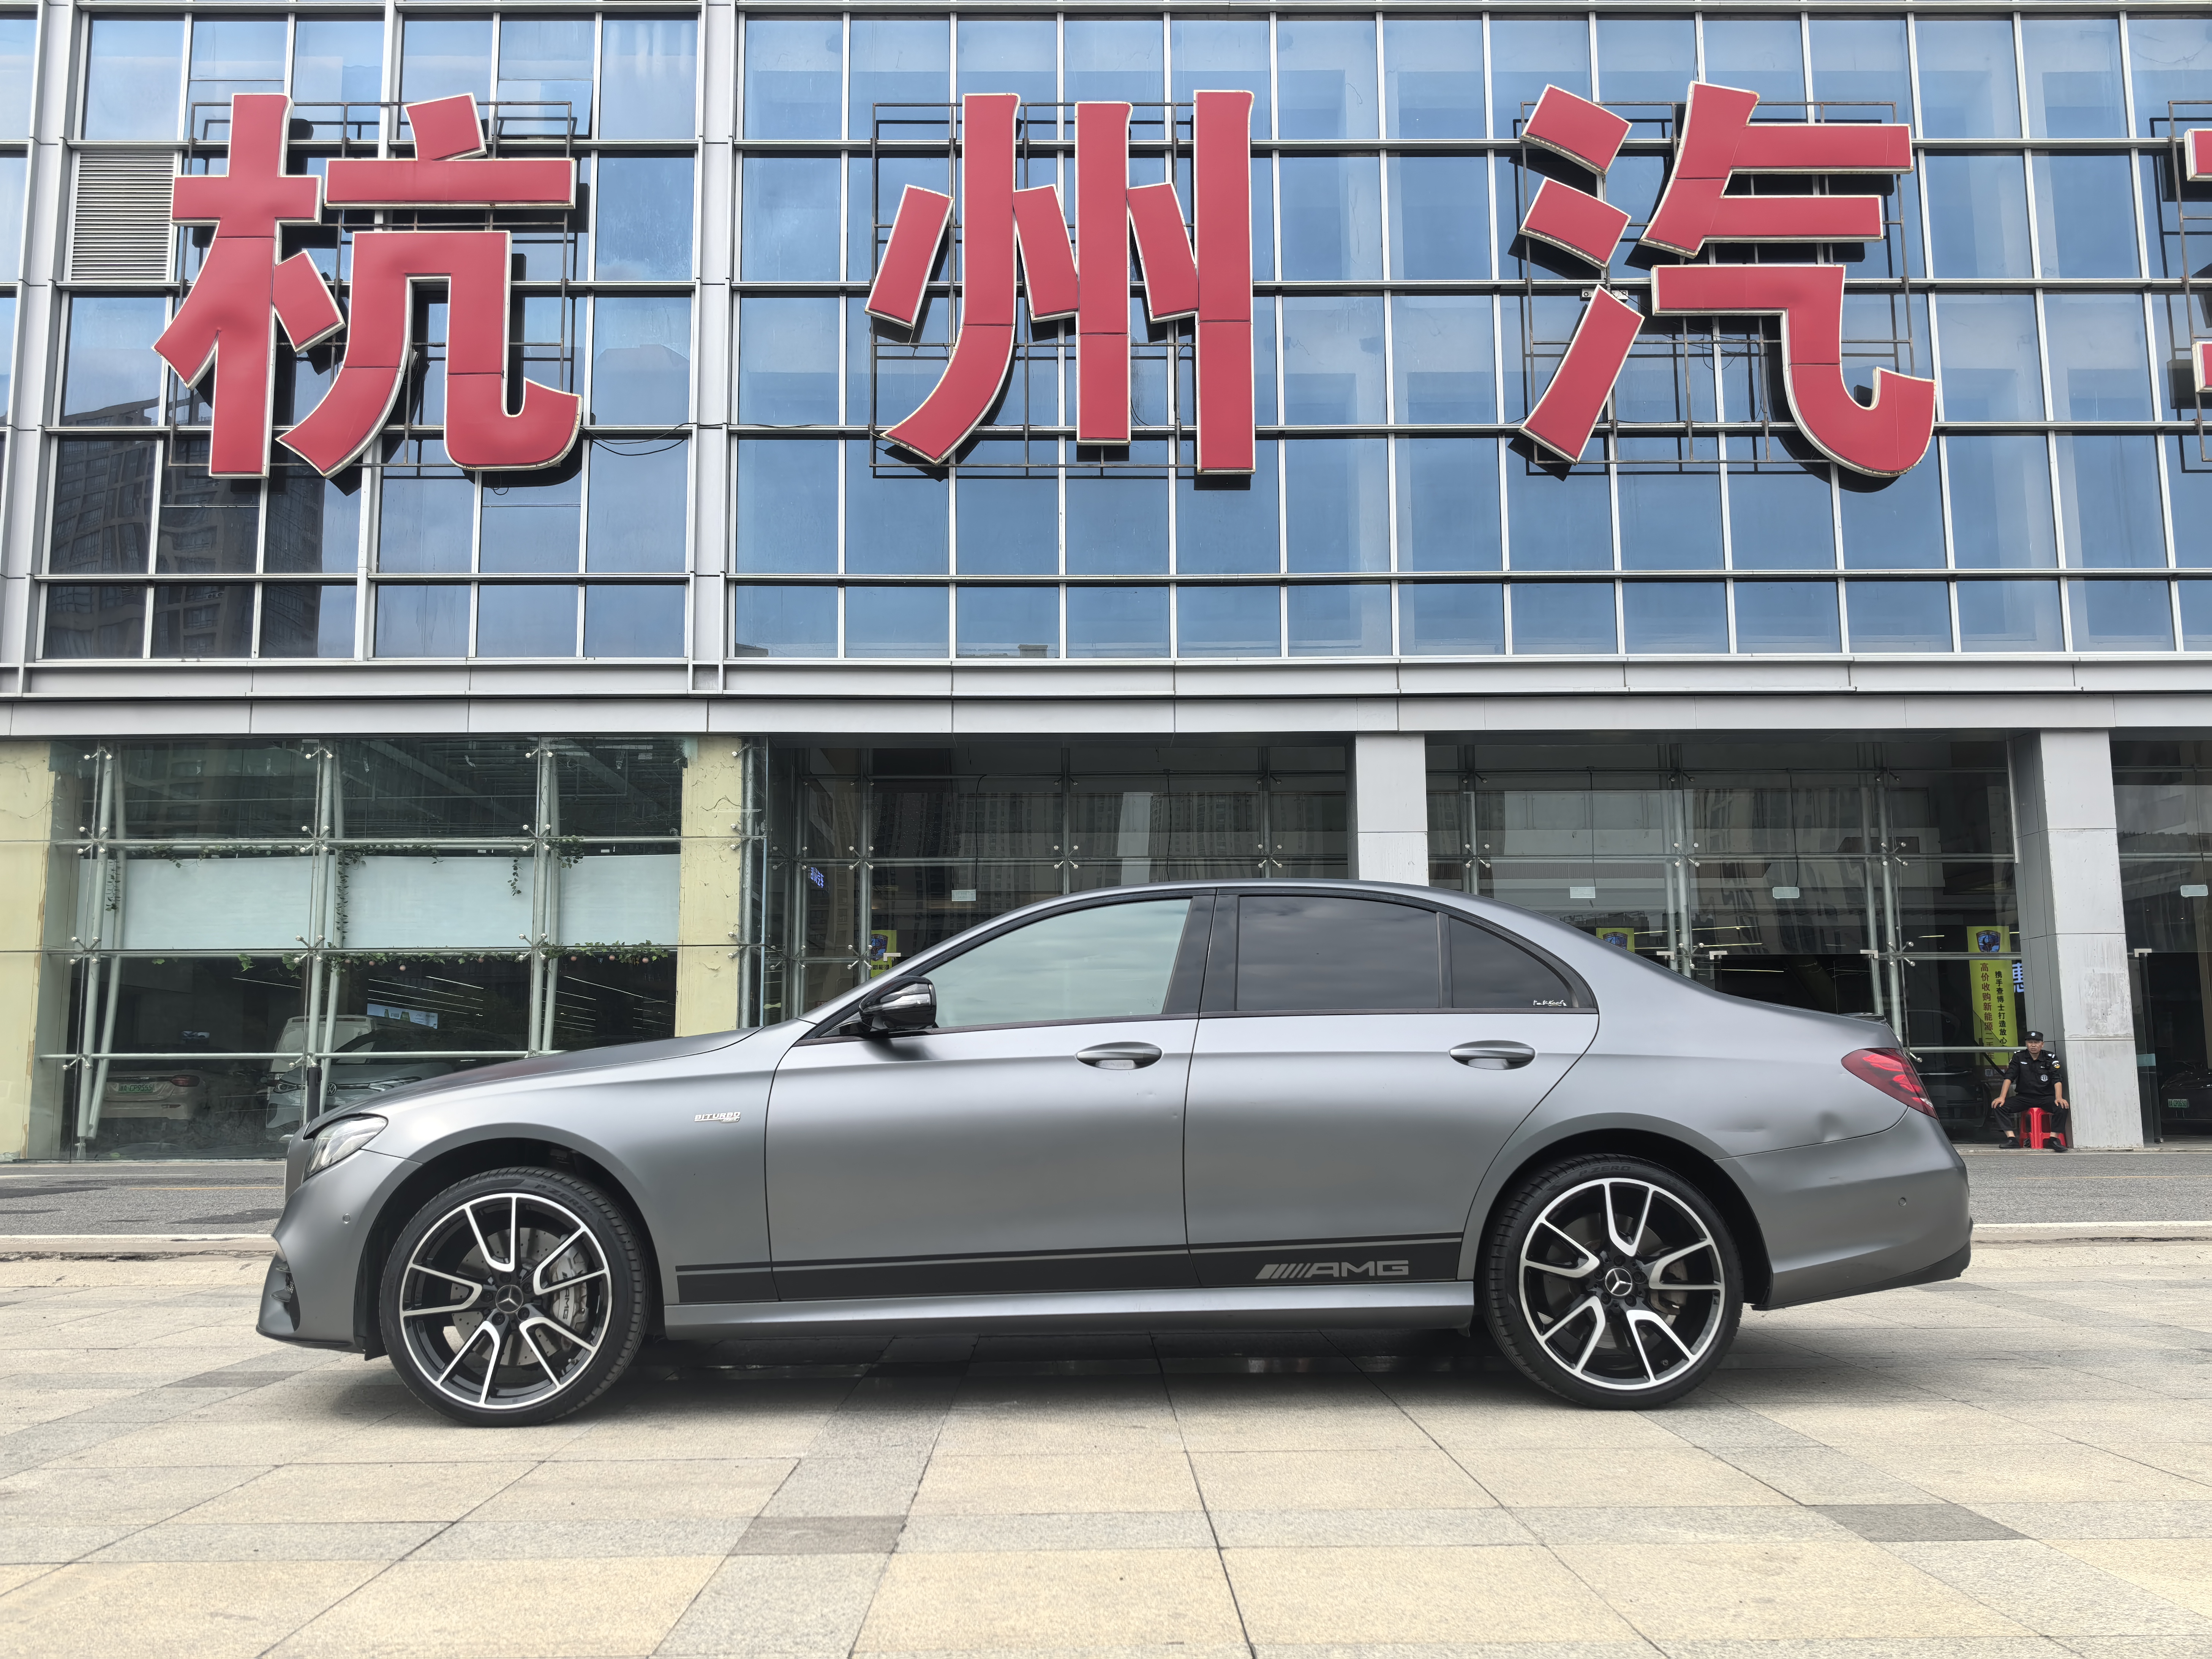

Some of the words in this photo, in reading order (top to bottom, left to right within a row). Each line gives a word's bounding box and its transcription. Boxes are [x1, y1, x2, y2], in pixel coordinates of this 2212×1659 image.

[1995, 970, 2008, 1046] 携手查博士打造放心
[694, 1111, 741, 1120] BITURBO
[1304, 1259, 1409, 1278] AMG
